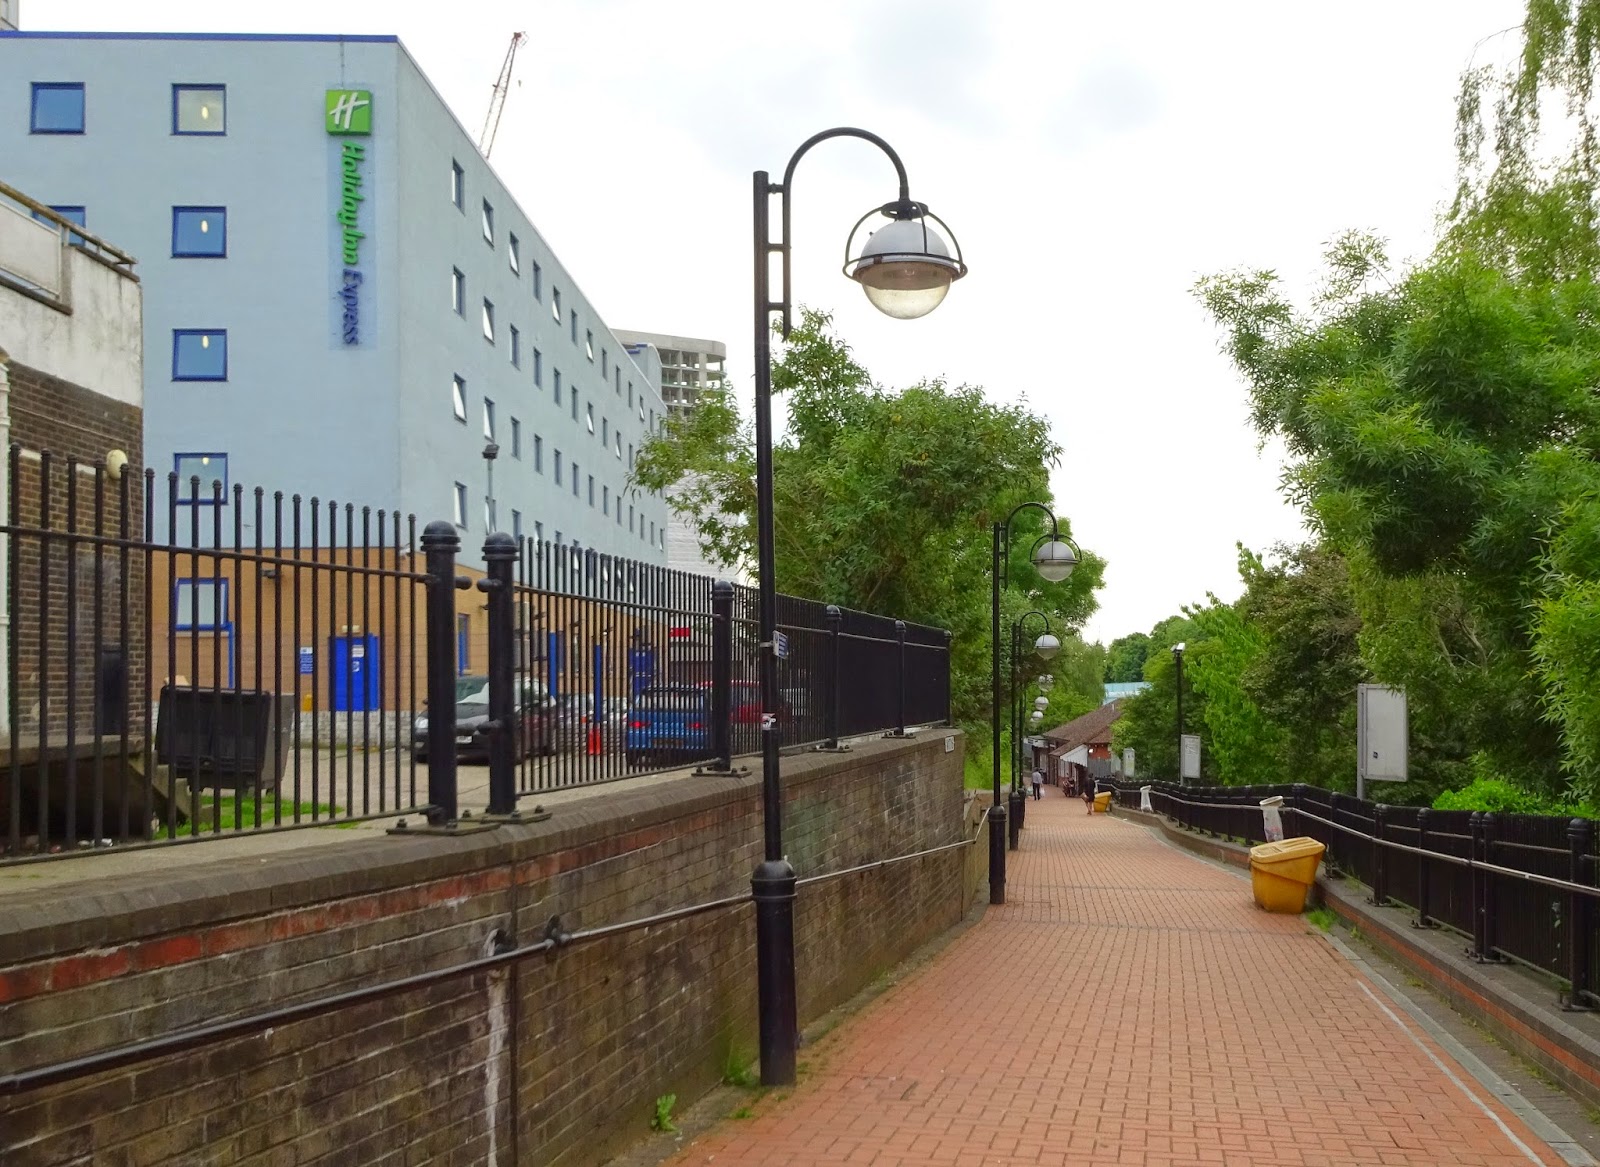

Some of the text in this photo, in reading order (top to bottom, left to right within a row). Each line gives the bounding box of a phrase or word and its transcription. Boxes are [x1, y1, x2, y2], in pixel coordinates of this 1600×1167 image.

[329, 92, 369, 129] H
[336, 140, 366, 346] Holiday Inn Express
